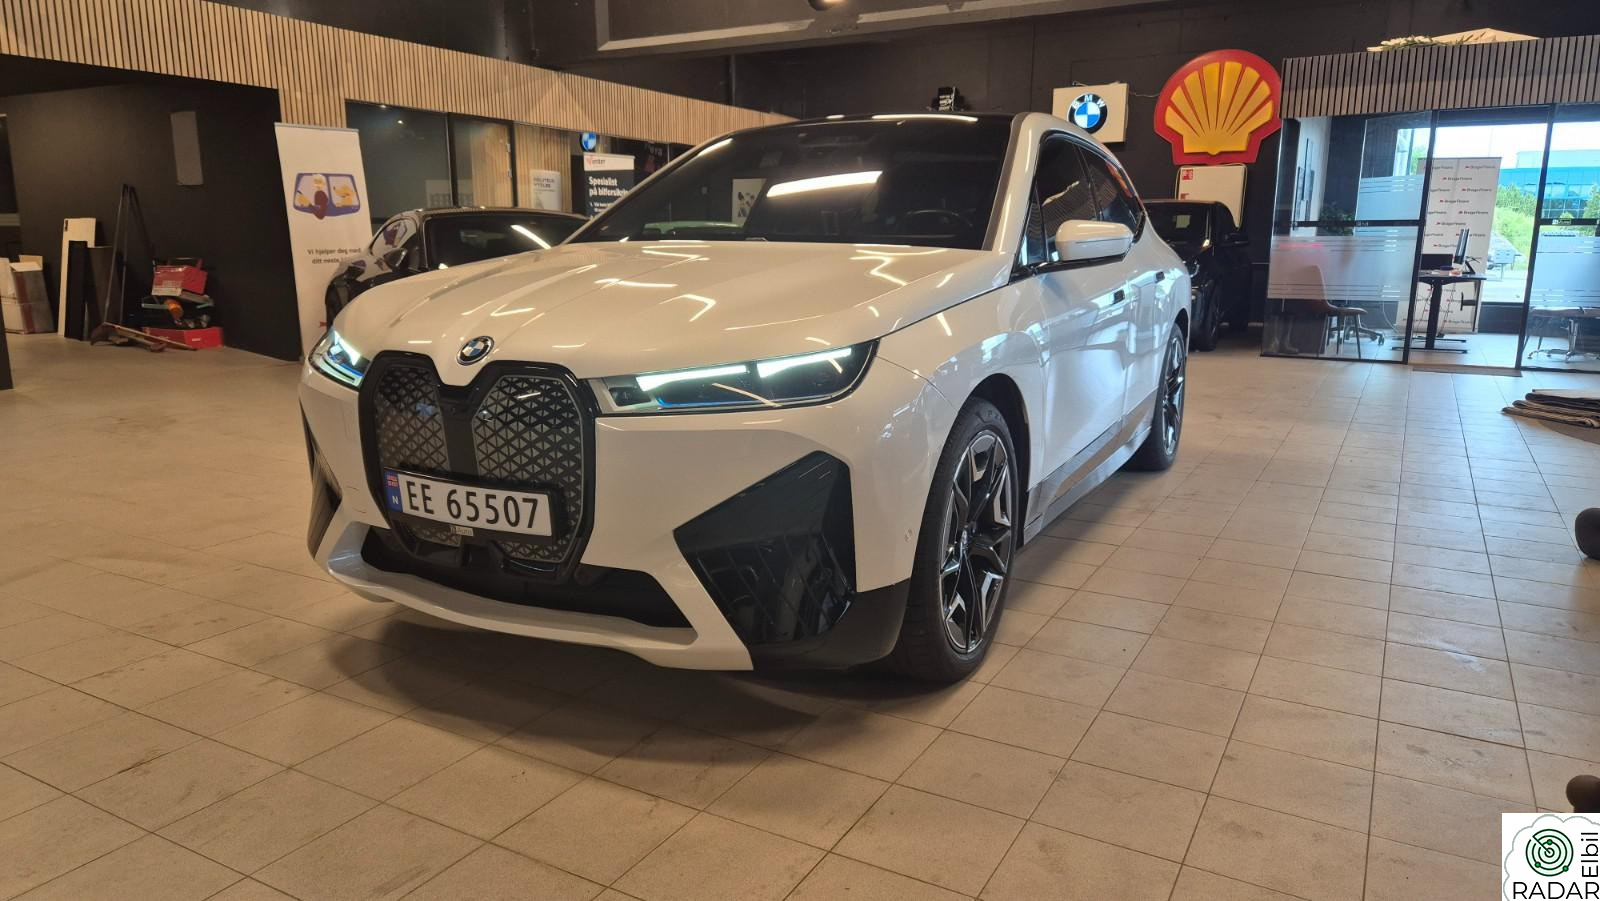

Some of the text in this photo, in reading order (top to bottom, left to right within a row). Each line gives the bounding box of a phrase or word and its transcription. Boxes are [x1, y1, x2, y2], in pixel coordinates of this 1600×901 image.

[1071, 94, 1106, 109] BMW
[589, 176, 617, 186] Spesialist
[589, 187, 597, 197] på
[392, 495, 399, 504] N
[406, 481, 538, 528] EE 65507
